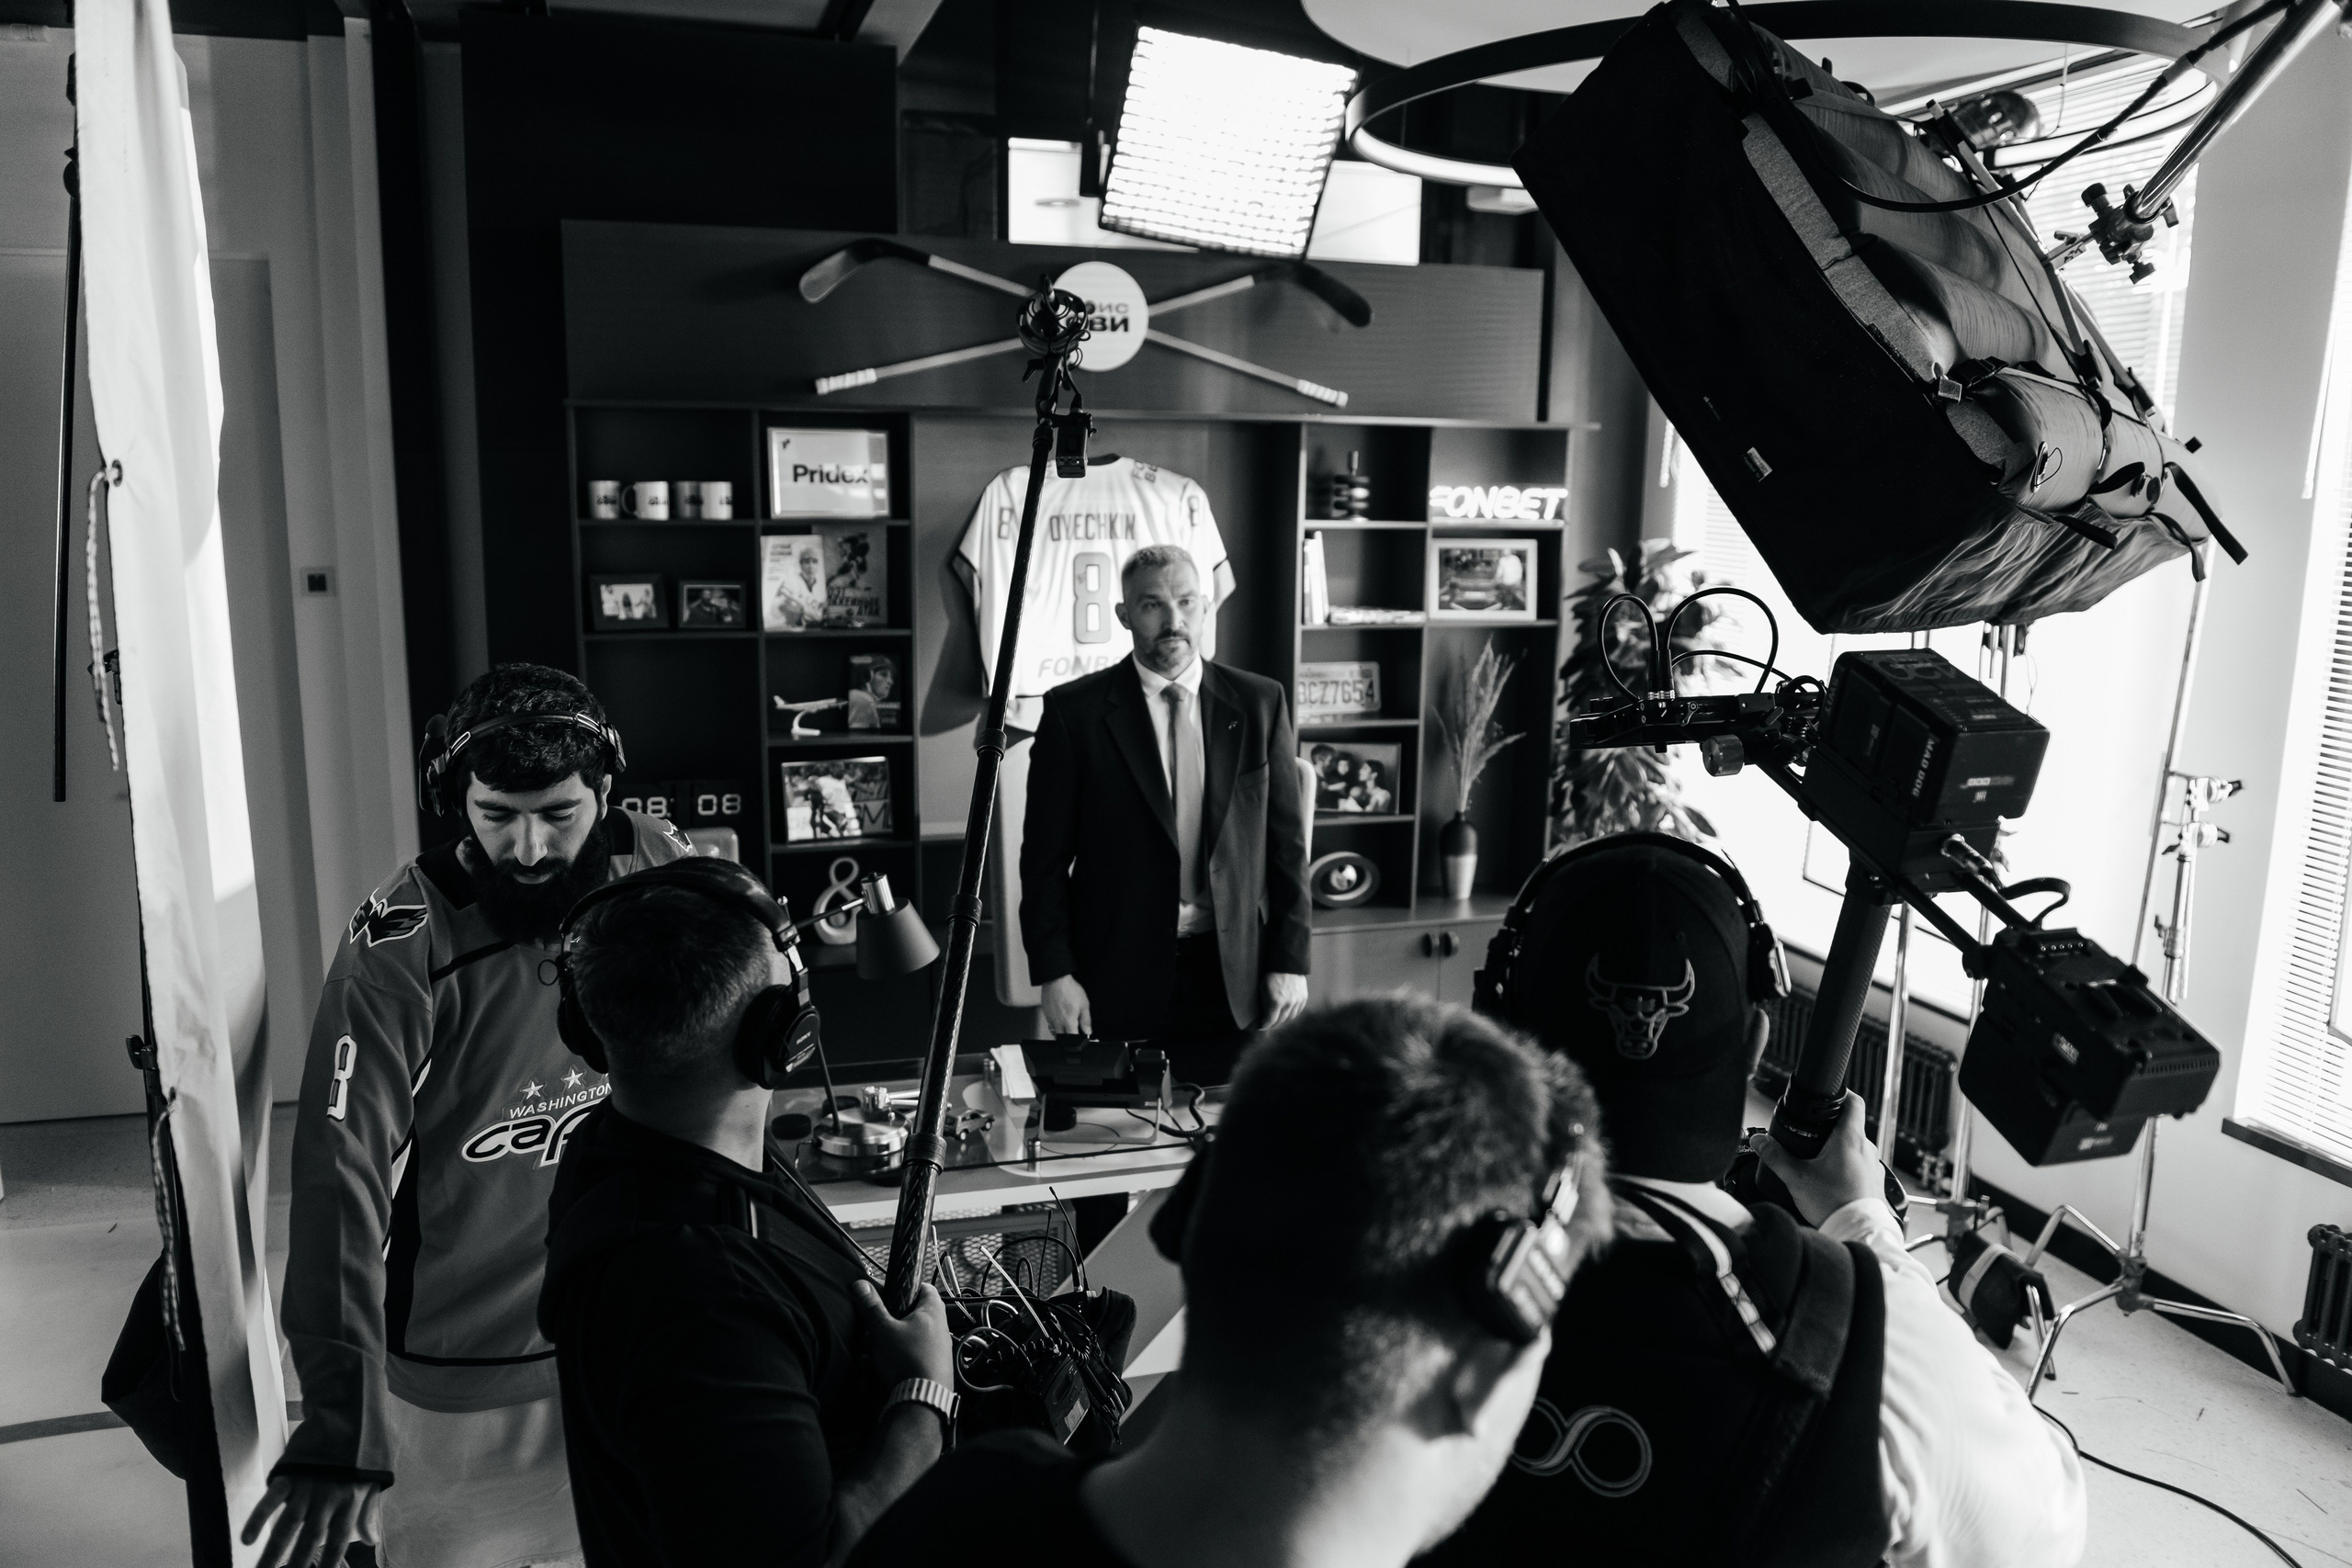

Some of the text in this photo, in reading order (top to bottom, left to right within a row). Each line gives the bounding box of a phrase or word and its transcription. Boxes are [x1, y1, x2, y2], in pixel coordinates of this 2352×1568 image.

[793, 463, 868, 483] Pridex
[1430, 485, 1569, 521] FONBET
[1073, 552, 1112, 644] 8
[1910, 737, 1936, 799] MAD DOG
[697, 794, 741, 816] 08
